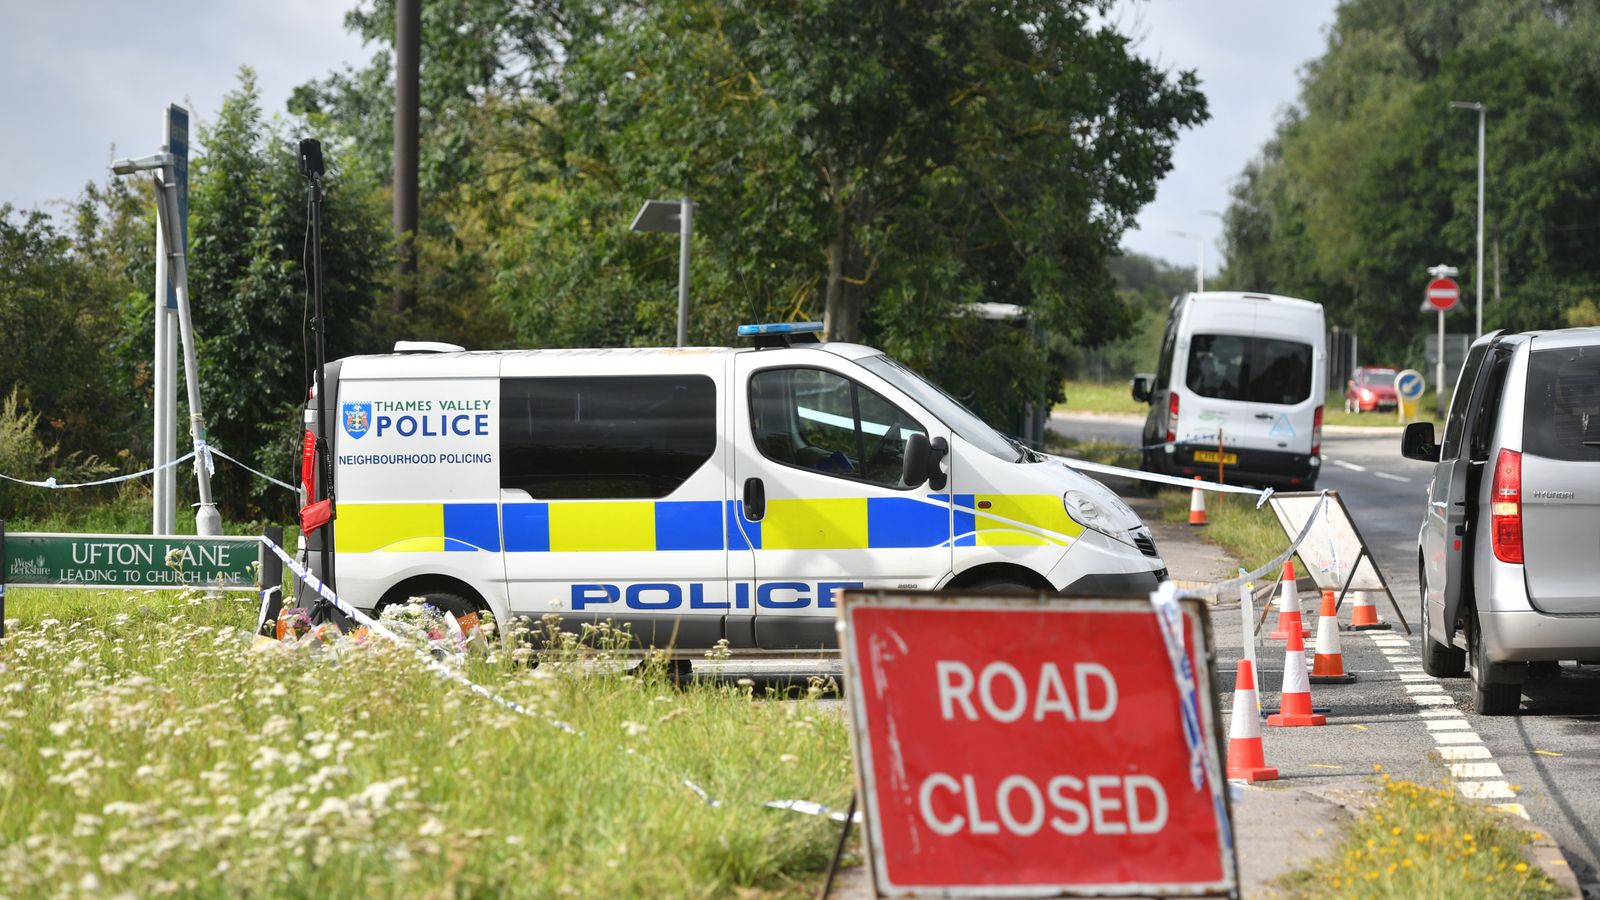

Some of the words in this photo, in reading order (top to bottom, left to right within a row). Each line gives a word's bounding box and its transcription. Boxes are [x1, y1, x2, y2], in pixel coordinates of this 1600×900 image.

[374, 401, 432, 412] THAMES
[439, 400, 492, 411] VALLEY
[376, 414, 489, 437] POLICE
[339, 454, 437, 465] NEIGHBOURHOOD
[439, 453, 492, 464] POLICING
[1533, 489, 1574, 500] HYUNDAI
[14, 557, 35, 568] West
[71, 542, 154, 565] UFTON
[164, 544, 231, 567] LANE
[10, 563, 51, 575] Berkshire
[60, 568, 117, 582] LEADING
[123, 570, 141, 582] TO
[145, 570, 201, 583] CHURCH
[206, 571, 241, 584] LANE
[570, 582, 864, 610] POLICE
[936, 661, 1119, 724] ROAD
[918, 772, 1169, 837] CLOSED
